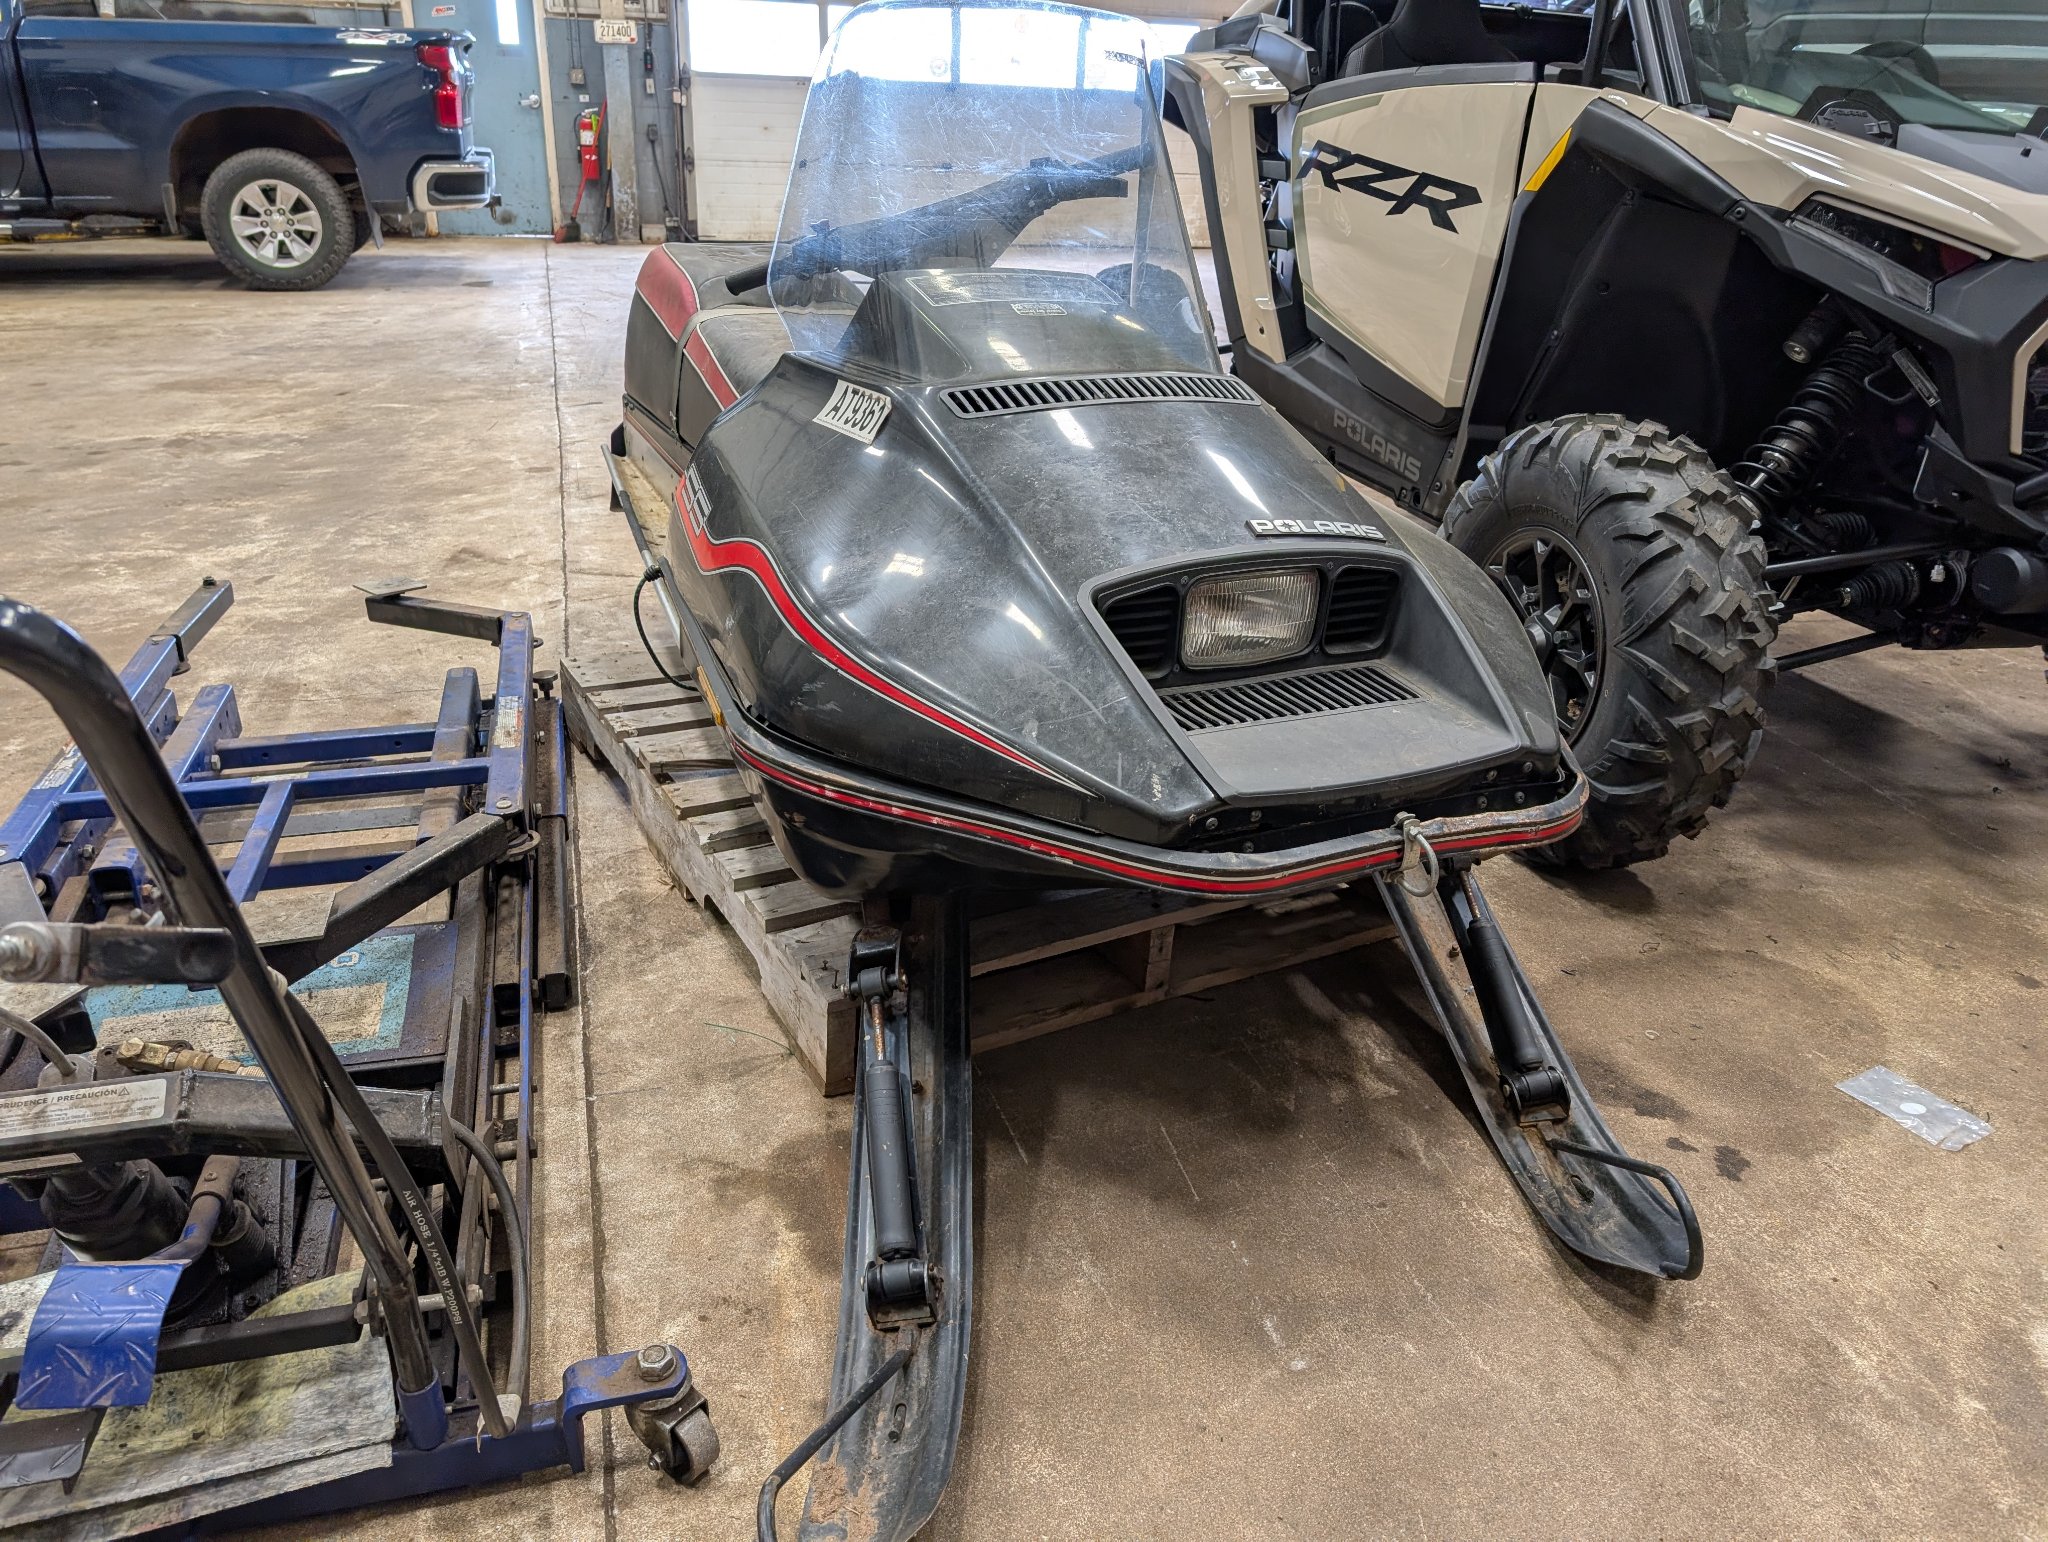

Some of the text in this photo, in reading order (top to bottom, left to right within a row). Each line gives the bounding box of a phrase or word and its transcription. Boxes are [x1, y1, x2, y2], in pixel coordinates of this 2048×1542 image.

[600, 25, 632, 37] 271400
[1295, 139, 1483, 235] RZR
[824, 384, 887, 435] AT9361
[1333, 408, 1422, 482] POLARIS
[1249, 519, 1385, 539] POLARIS
[57, 1088, 118, 1102] PRECAUCIÓN
[403, 1190, 417, 1208] AIR
[413, 1209, 432, 1239] HOSE
